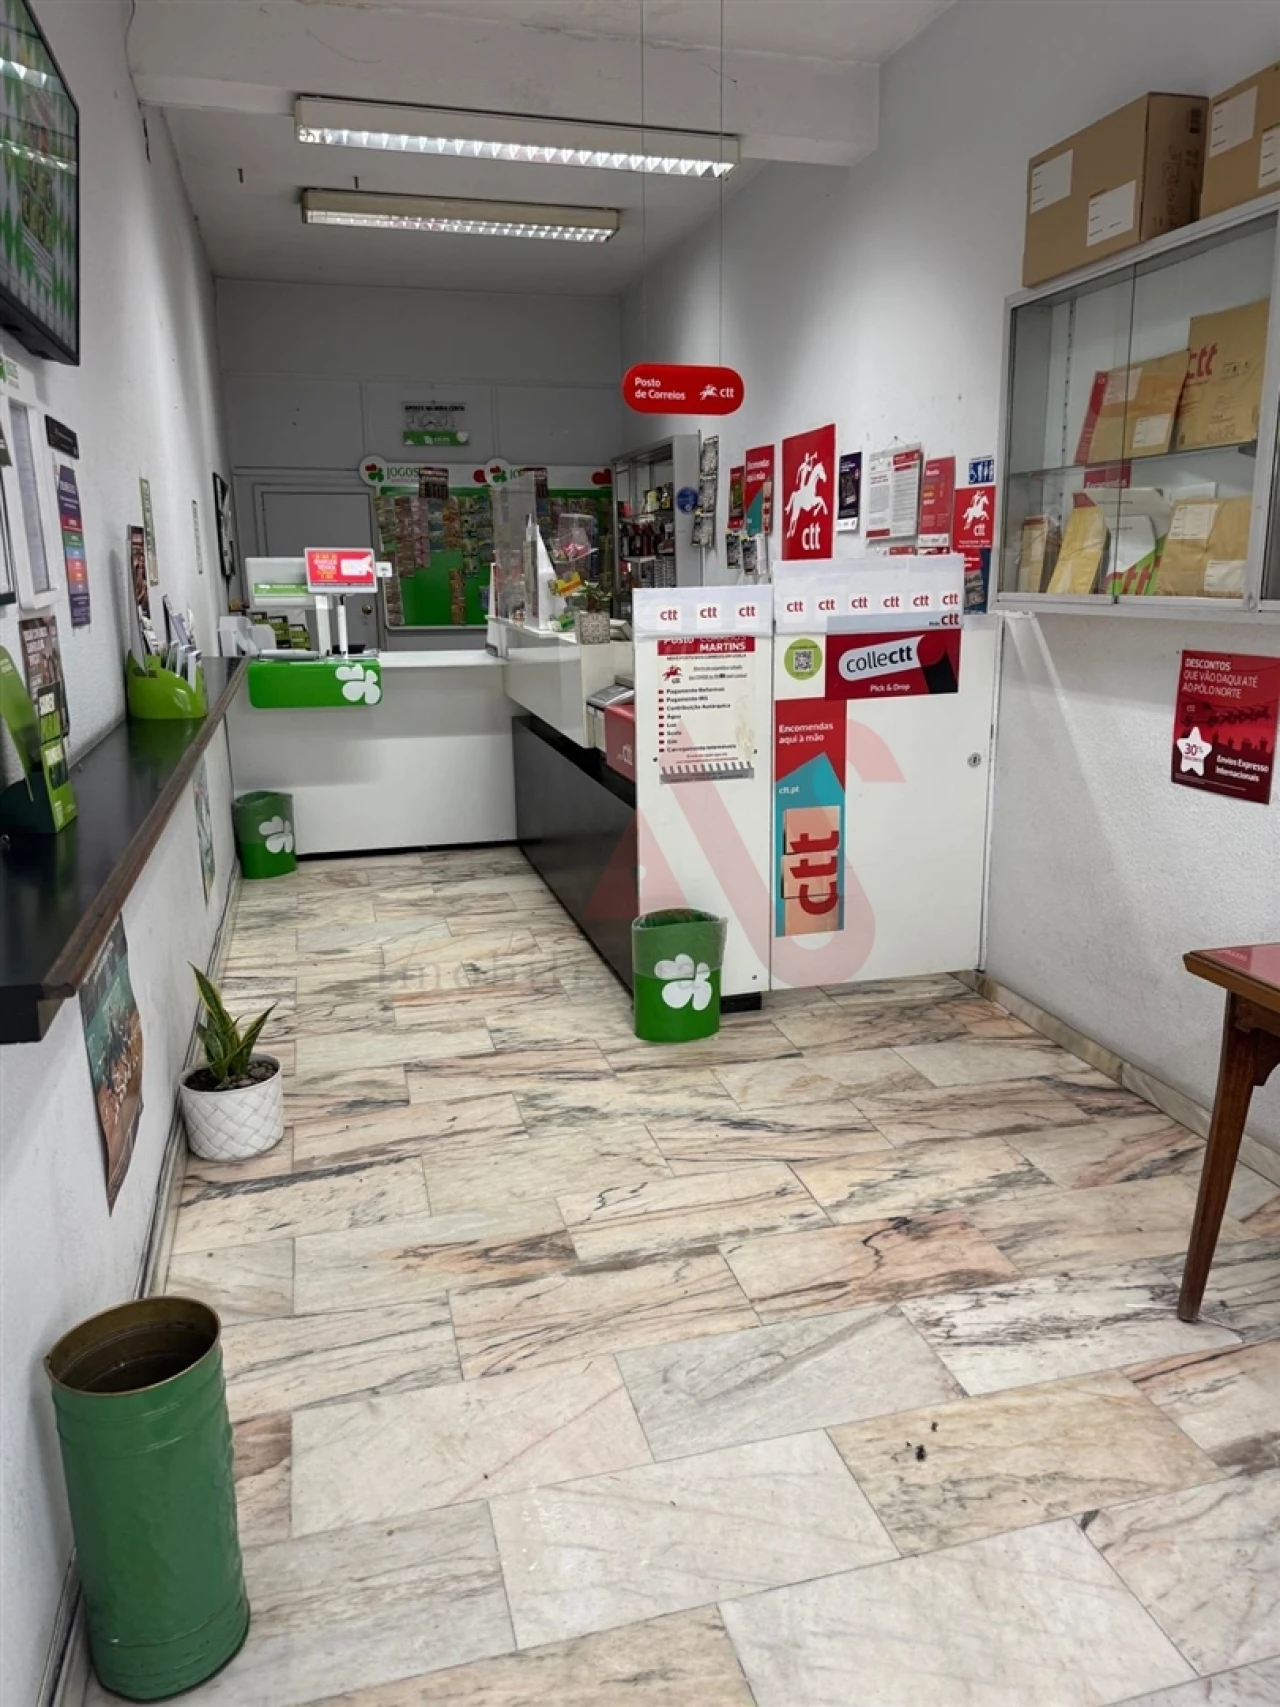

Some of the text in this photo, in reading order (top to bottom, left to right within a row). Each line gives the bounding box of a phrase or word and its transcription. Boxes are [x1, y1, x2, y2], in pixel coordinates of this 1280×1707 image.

[1187, 343, 1217, 380] ctt
[634, 377, 661, 388] Posto
[634, 389, 687, 400] de Correios
[719, 387, 734, 398] ctt
[802, 522, 820, 551] ctt
[818, 599, 836, 612] ctt
[851, 596, 868, 609] ctt
[883, 596, 900, 609] ctt
[912, 594, 930, 607] ctt
[942, 593, 959, 605] ctt
[700, 606, 718, 619] ctt
[738, 605, 756, 618] ctt
[786, 600, 804, 613] ctt
[660, 608, 678, 621] ctt
[941, 613, 959, 625] ctt
[700, 641, 747, 652] MARTINS
[846, 645, 912, 673] collectt
[1185, 658, 1231, 671] DESCONTOS
[1184, 670, 1258, 688] QUE VÃO DAQUI ATÉ
[870, 684, 886, 692] Pick
[894, 683, 910, 692] Drop
[1182, 682, 1242, 699] AO PÓLO NORTE
[779, 722, 833, 733] Encomendas
[779, 735, 797, 744] aqui
[806, 733, 825, 742] mão
[1216, 754, 1238, 766] Envios
[1238, 758, 1269, 773] Expresso
[1215, 765, 1259, 782] Internacionais
[779, 786, 799, 794] ctt.pt
[790, 830, 840, 915] ctt
